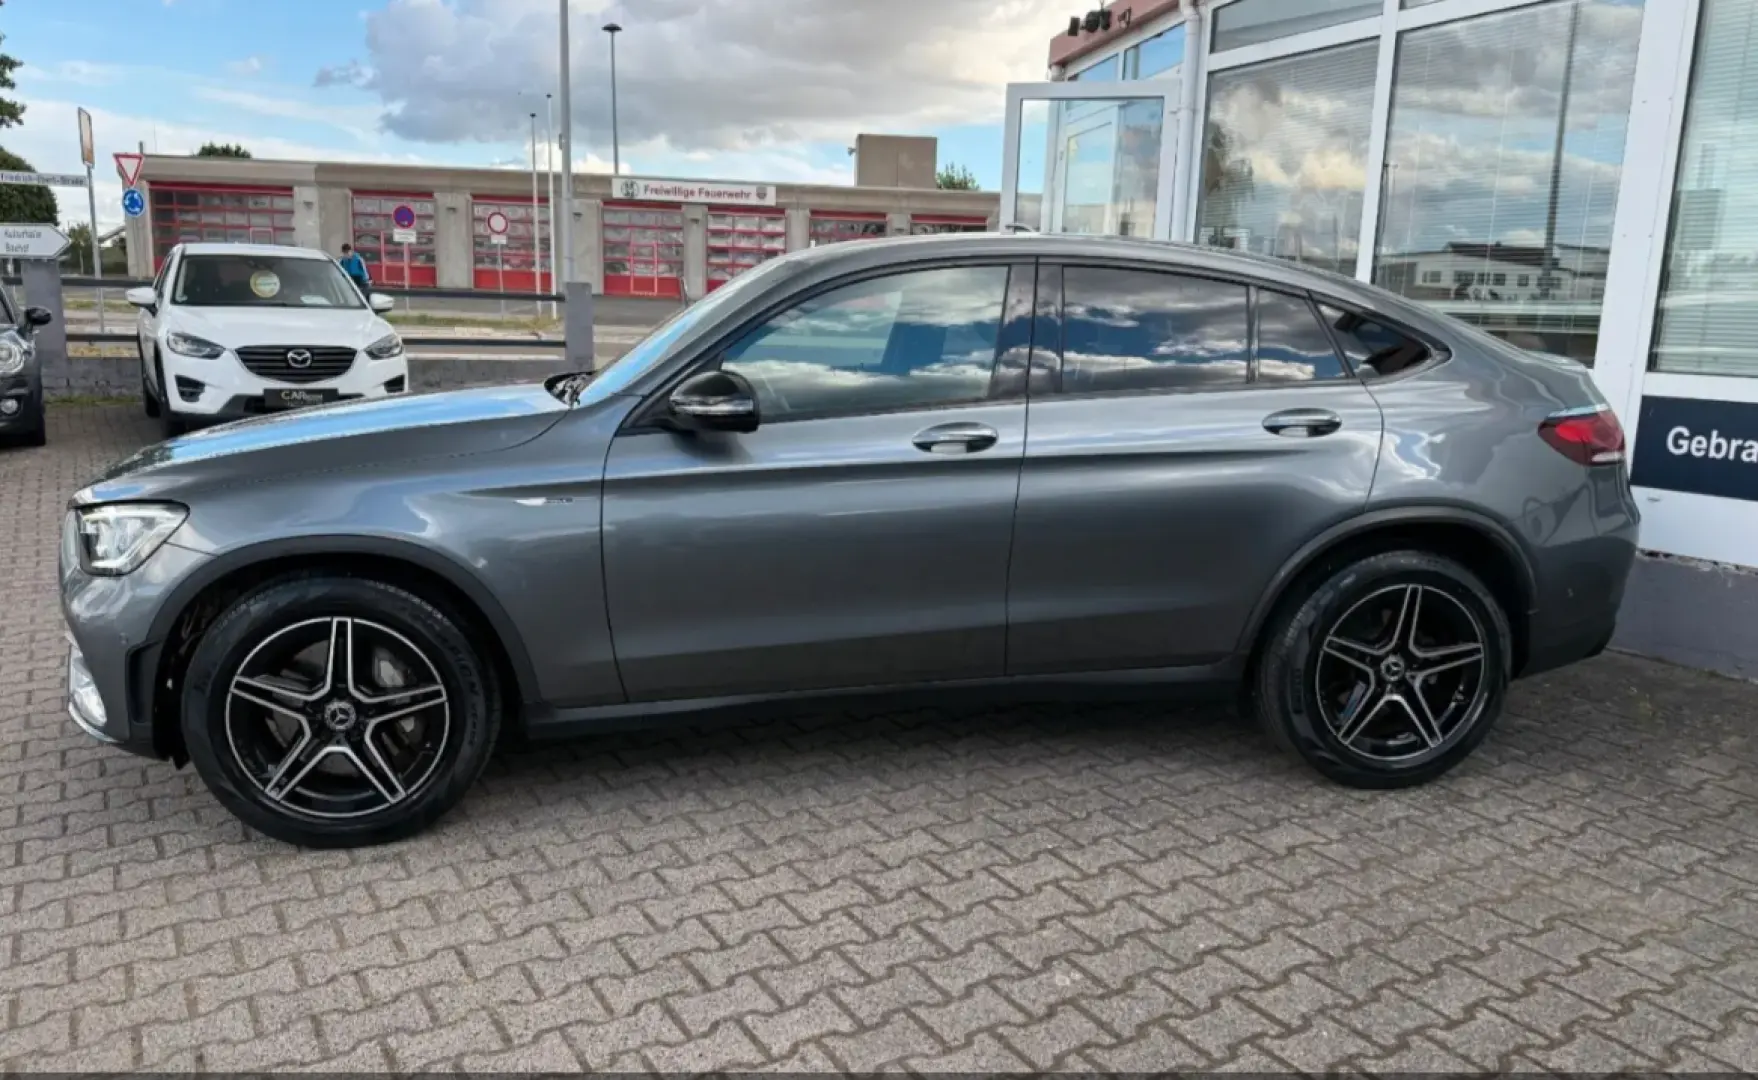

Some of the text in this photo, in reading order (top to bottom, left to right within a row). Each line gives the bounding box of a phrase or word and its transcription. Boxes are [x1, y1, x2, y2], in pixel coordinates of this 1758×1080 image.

[644, 184, 752, 199] Freiwillige Feuerwehr
[1666, 425, 1758, 462] Gebra
